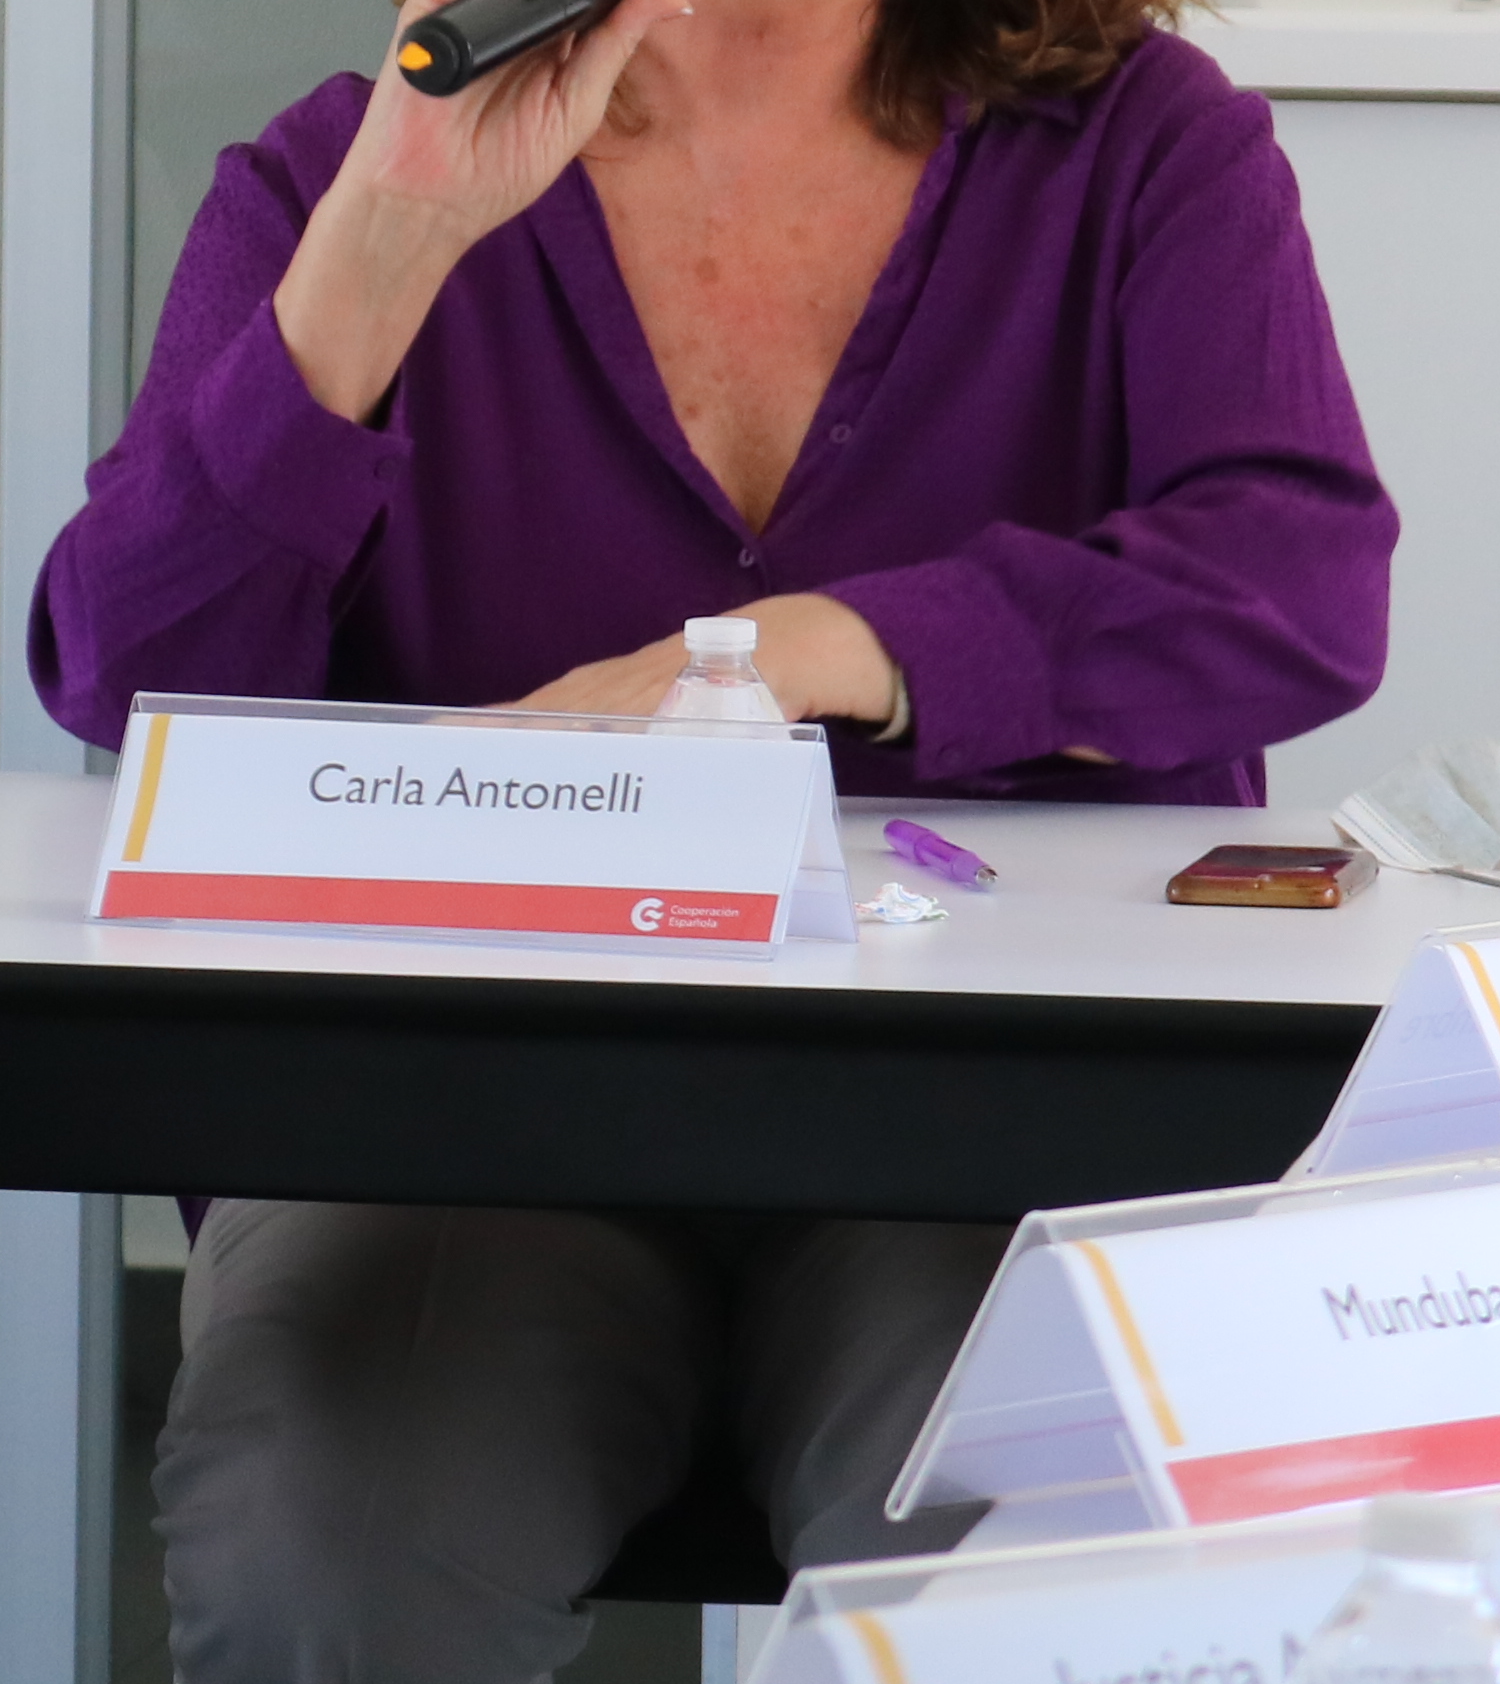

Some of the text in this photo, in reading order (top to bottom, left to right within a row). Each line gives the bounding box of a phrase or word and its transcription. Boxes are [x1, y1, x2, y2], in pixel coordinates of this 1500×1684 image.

[308, 761, 645, 814] Carla Antonelli
[670, 904, 740, 917] Cooperación
[668, 916, 718, 929] Española
